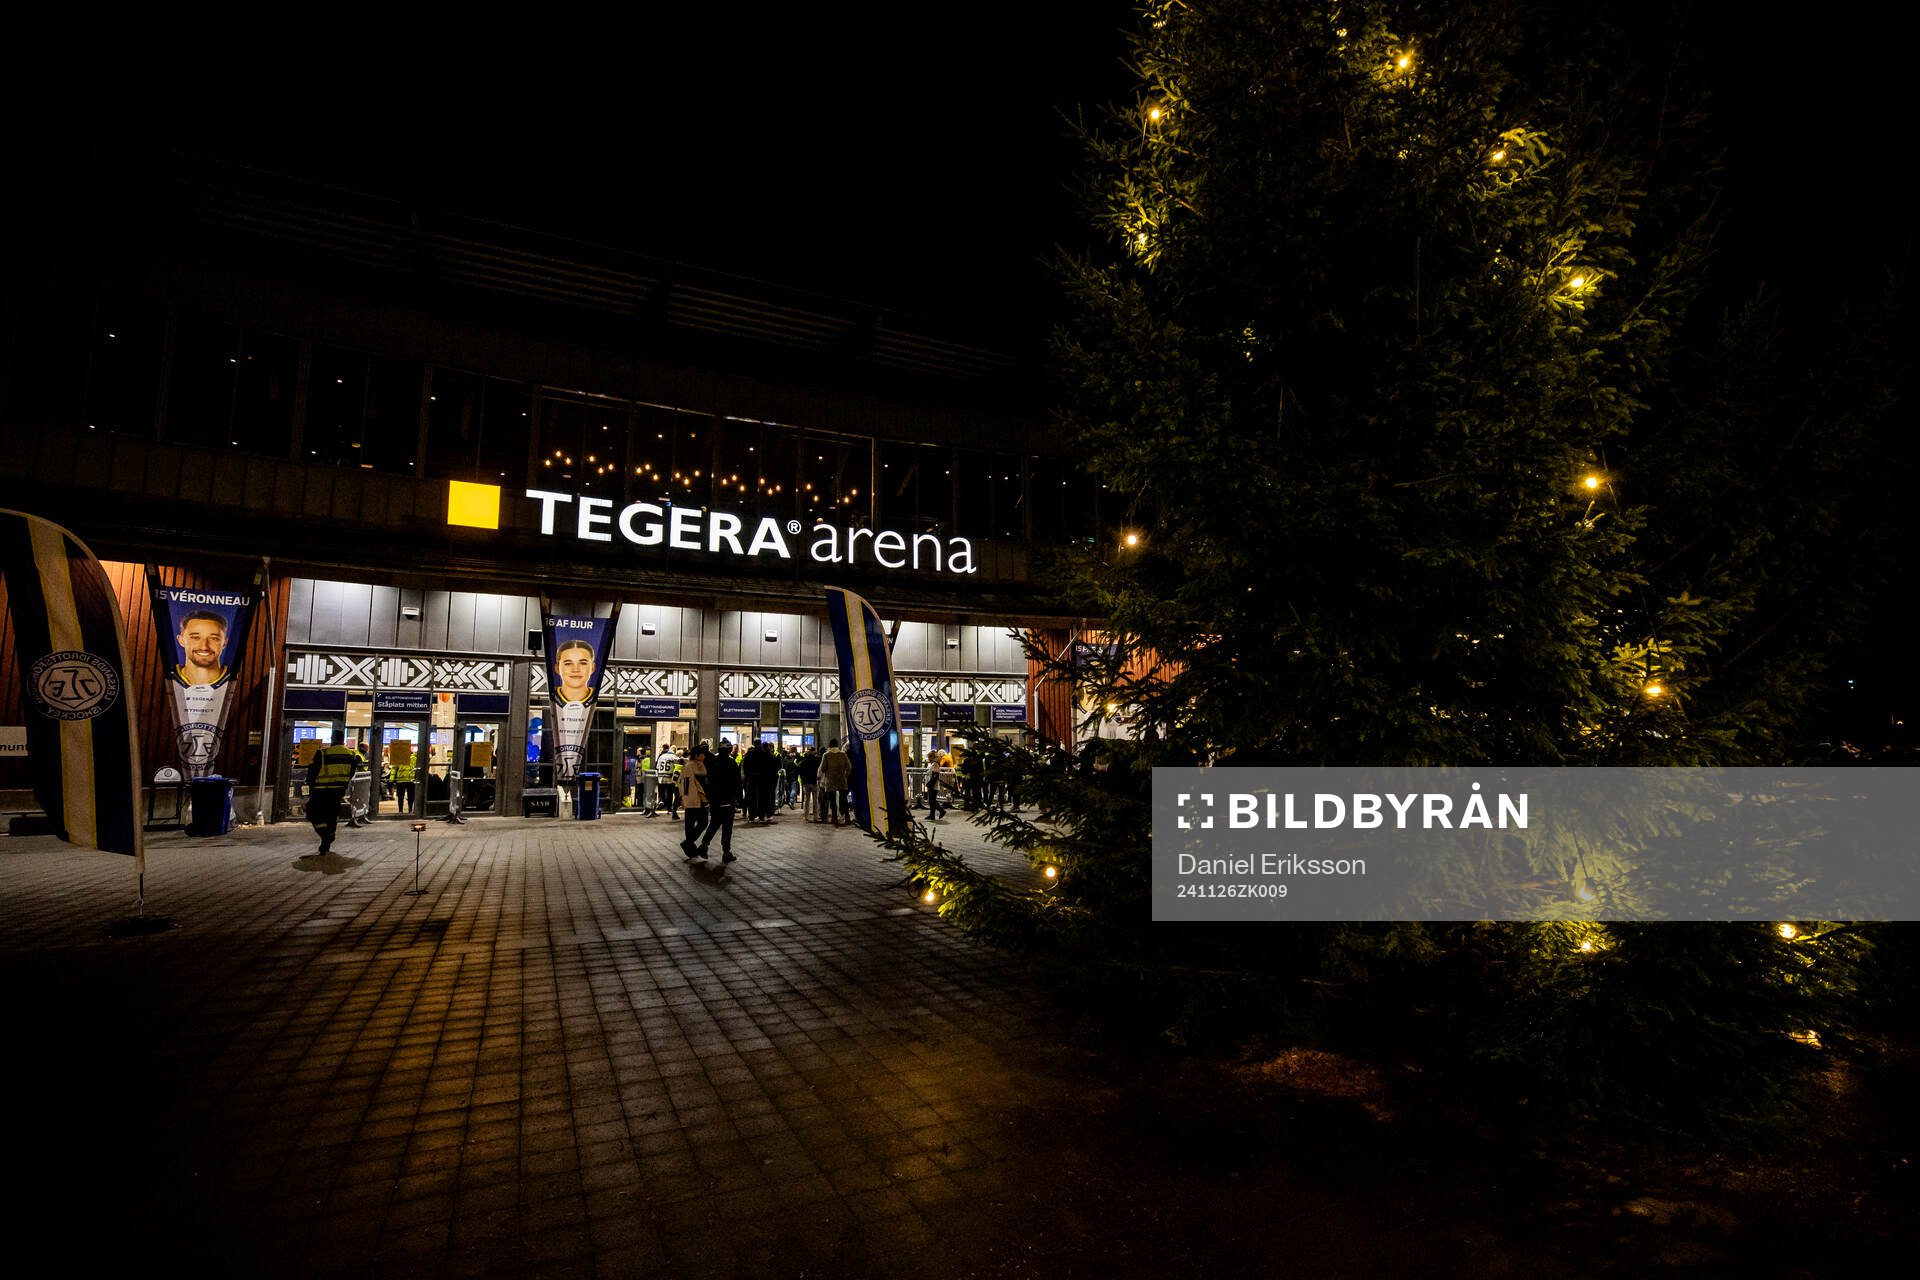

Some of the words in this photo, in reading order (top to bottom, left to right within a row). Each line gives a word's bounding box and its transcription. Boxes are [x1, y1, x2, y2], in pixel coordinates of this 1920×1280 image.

[810, 522, 977, 574] arena
[169, 590, 251, 607] VÉRONNEAU
[556, 618, 569, 628] AF
[570, 619, 593, 630] BJUR
[377, 699, 405, 710] Ståplats
